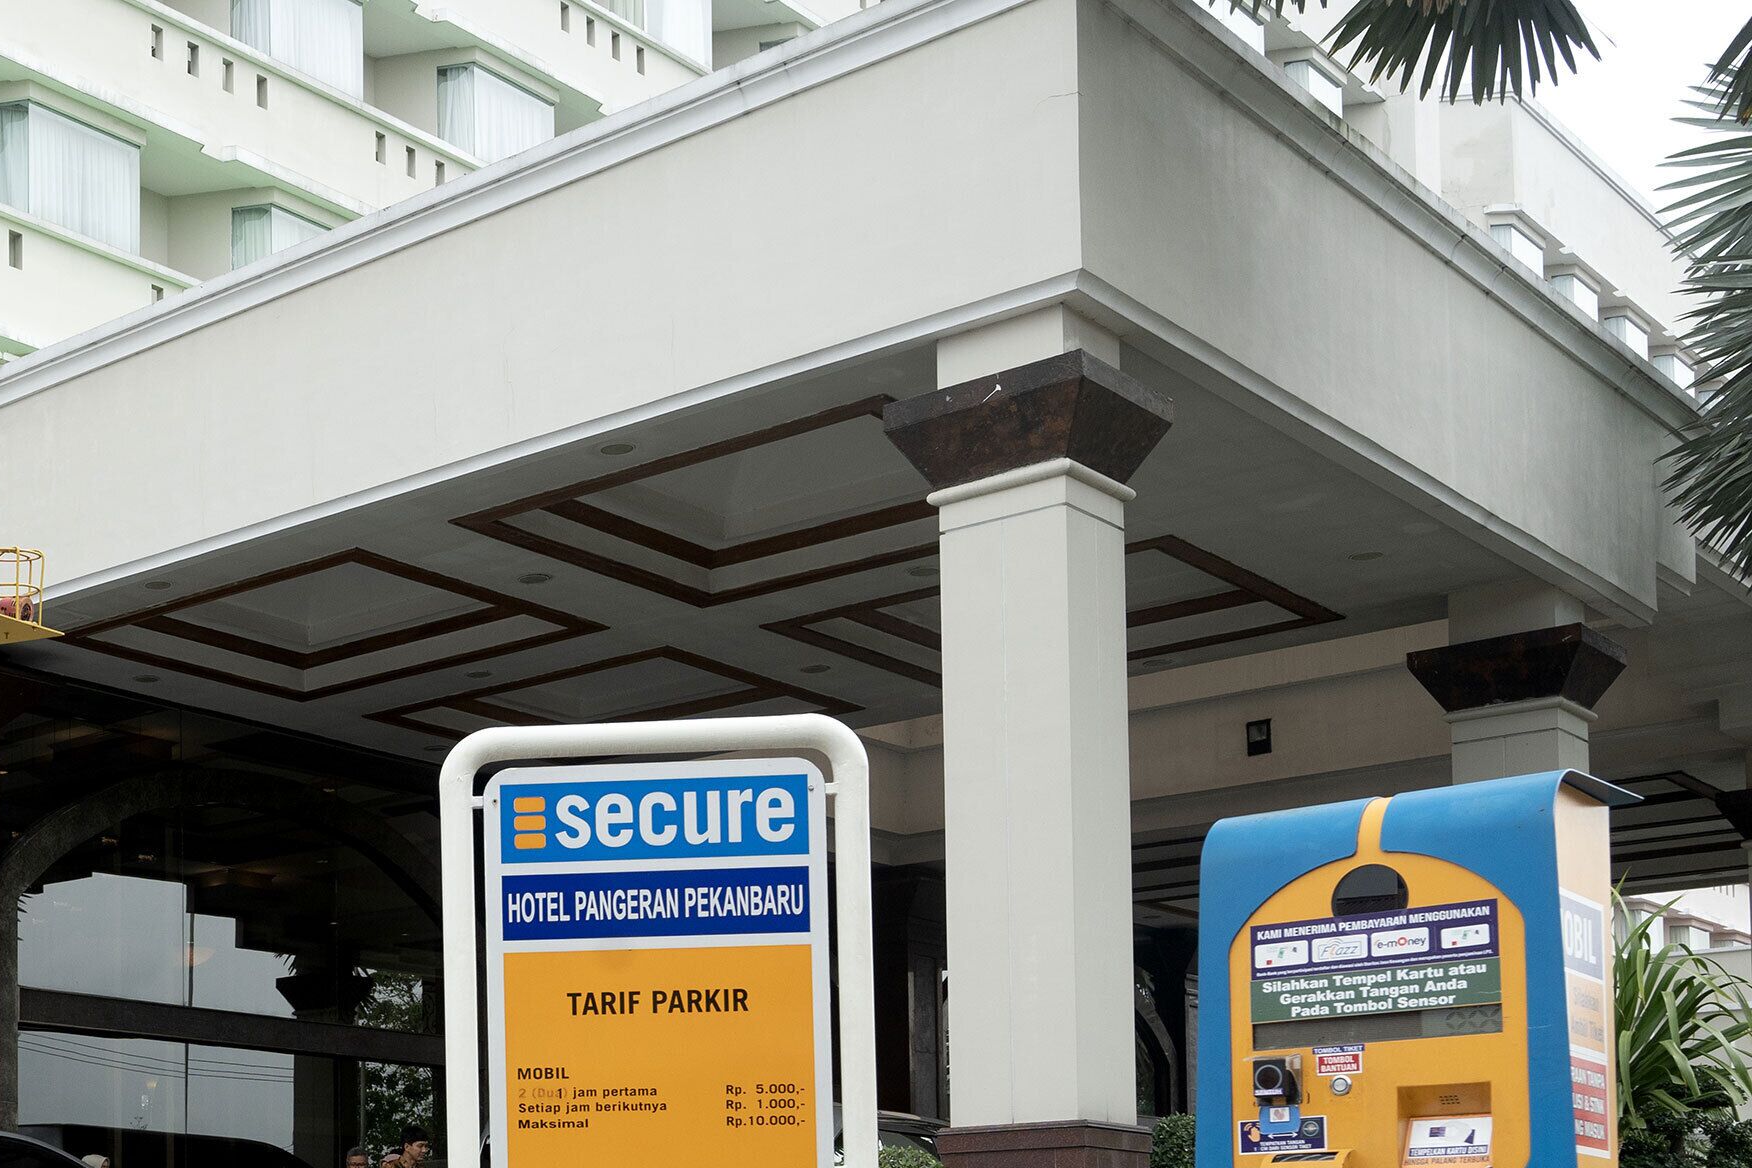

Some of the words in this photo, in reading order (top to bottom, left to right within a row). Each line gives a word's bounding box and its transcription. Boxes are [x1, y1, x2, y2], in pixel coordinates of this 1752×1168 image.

[554, 787, 795, 849] secure
[508, 891, 571, 923] HOTEL
[574, 887, 679, 921] PANGERAN
[684, 884, 804, 918] PEKANBARU
[1256, 928, 1282, 941] KAMI
[1283, 922, 1337, 938] MENERIMA
[1337, 915, 1407, 932] PEMBAYARAN
[1408, 905, 1490, 924] MENGGUNAKAN
[1376, 935, 1426, 949] e-money
[1262, 978, 1329, 994] Silahkan
[1332, 970, 1392, 987] Tempel
[1396, 966, 1444, 981] Kartu
[1448, 963, 1487, 976] atau
[1279, 989, 1356, 1005] Gerakkan
[1358, 984, 1420, 998] Tangan
[1423, 978, 1468, 993] Anda
[566, 990, 641, 1016] TARIF
[652, 988, 749, 1014] PARKIR
[1291, 1004, 1330, 1018] Pada
[1333, 997, 1393, 1014] Tombol
[1396, 994, 1457, 1009] Sensor
[1313, 1046, 1342, 1054] TOMBOL
[1320, 1063, 1358, 1073] BANTUAN
[1322, 1055, 1355, 1064] TOMBOL
[517, 1067, 570, 1080] MOBIL
[572, 1086, 597, 1100] jam
[602, 1087, 658, 1100] pertama
[725, 1084, 747, 1097] Rp.
[755, 1083, 805, 1095] 5.000,-
[518, 1102, 561, 1115] Setiap
[565, 1101, 590, 1115] jam
[595, 1100, 667, 1114] berikutnya
[725, 1099, 747, 1112] Rp.
[757, 1098, 806, 1110] 1.000,-
[518, 1118, 589, 1129] Maksimal
